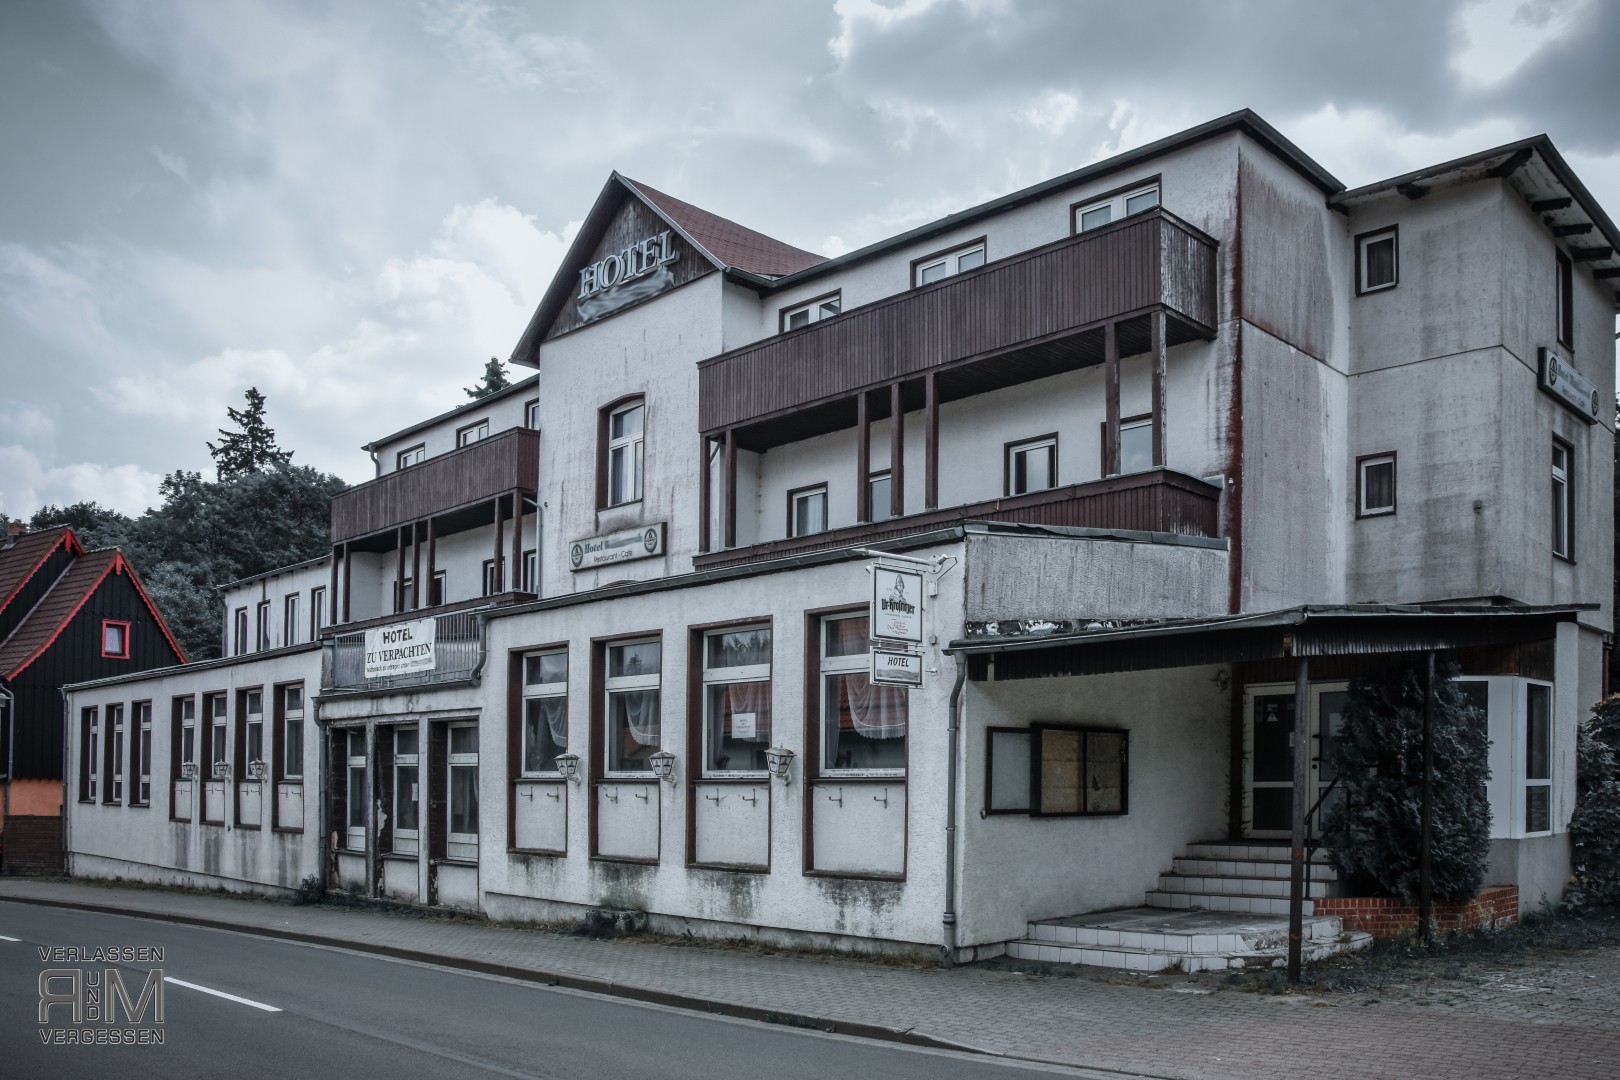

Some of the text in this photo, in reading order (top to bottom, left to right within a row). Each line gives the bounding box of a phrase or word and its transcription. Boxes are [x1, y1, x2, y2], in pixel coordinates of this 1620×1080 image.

[577, 230, 679, 301] HOTEL
[584, 541, 603, 554] Hotel
[594, 553, 617, 563] Restaurant
[383, 628, 413, 644] HOTEL
[367, 642, 432, 663] ZU VERPACHTEN
[887, 656, 909, 667] HOTEL
